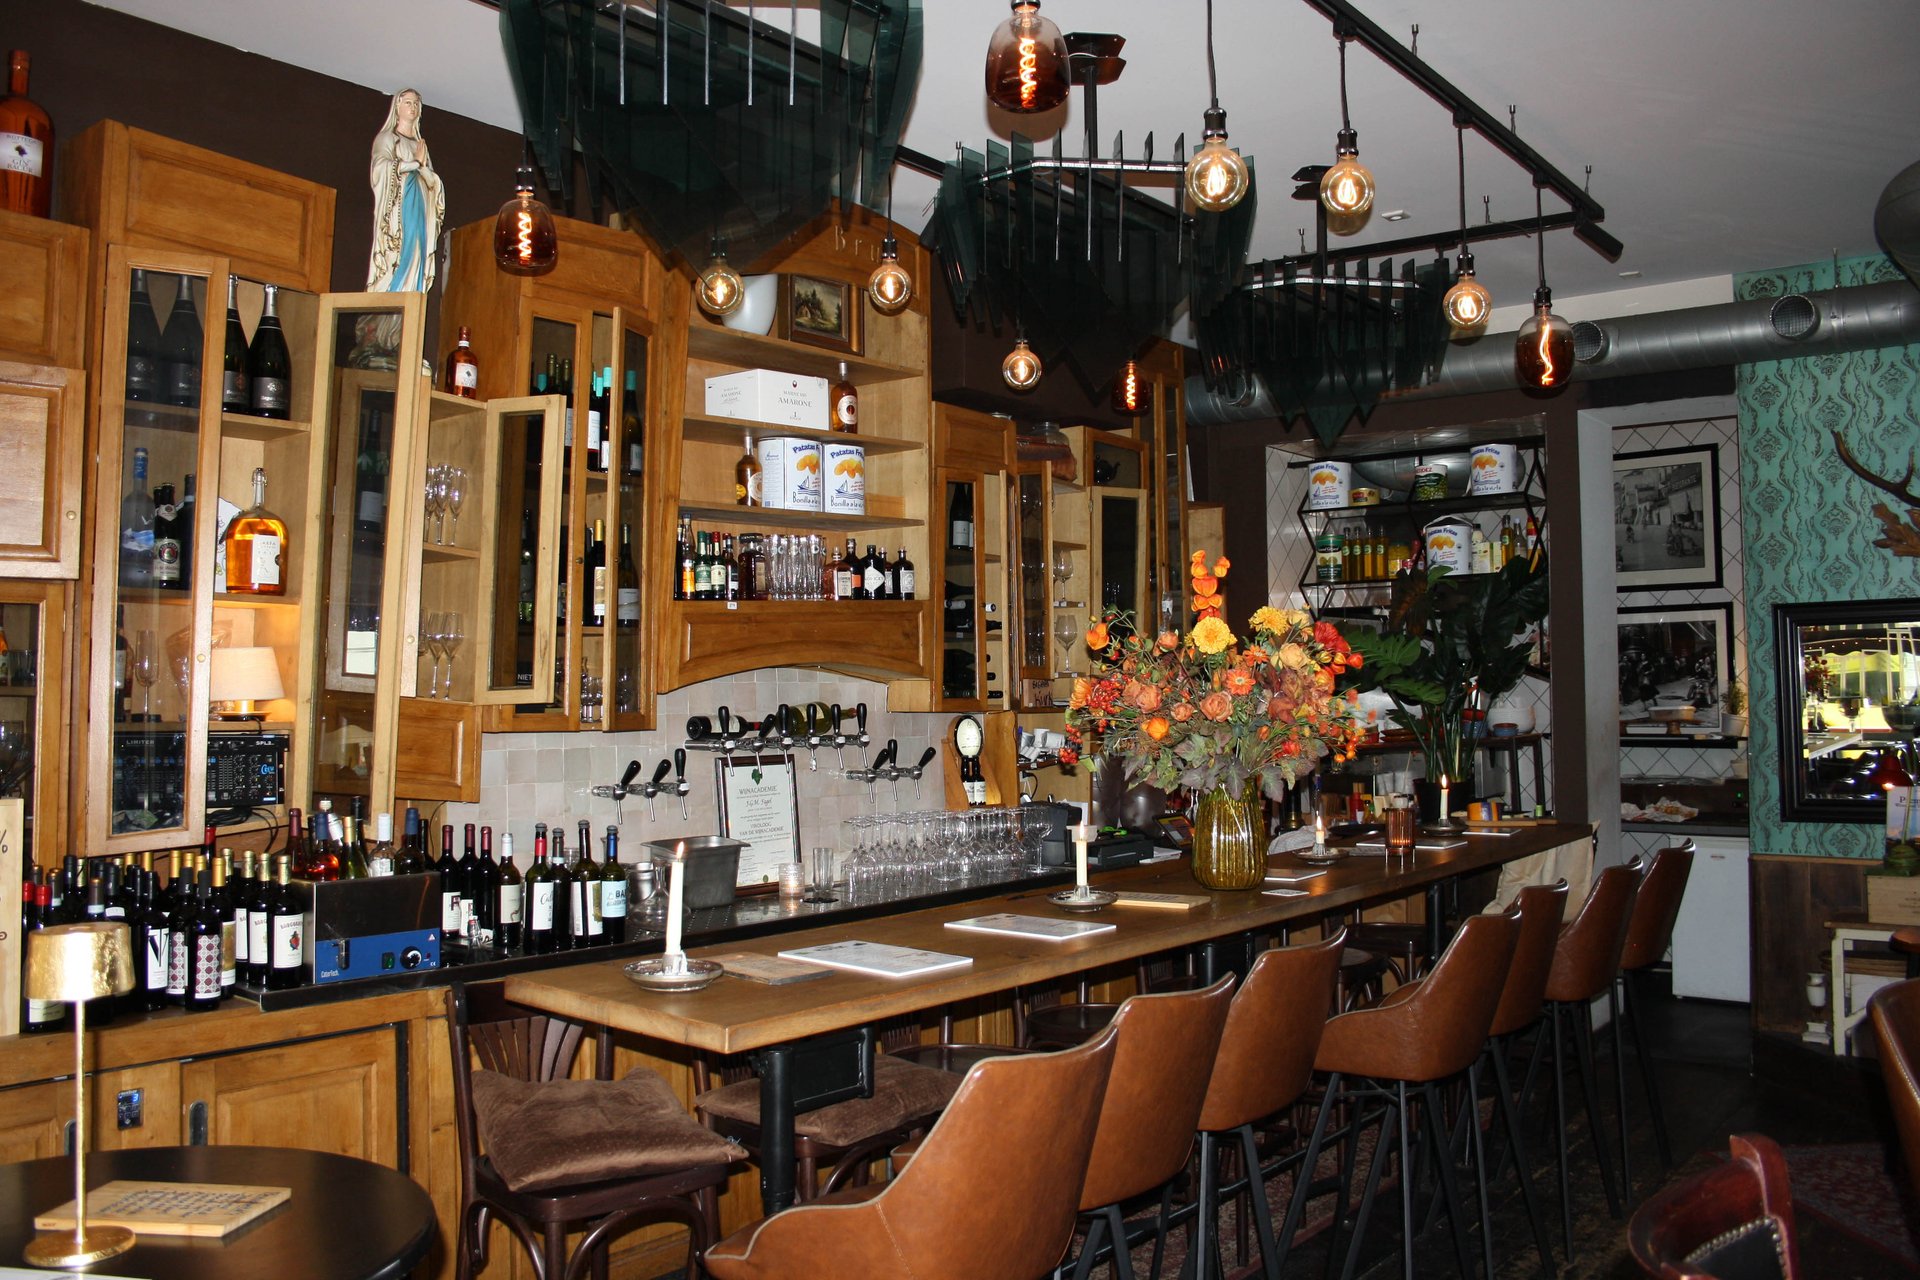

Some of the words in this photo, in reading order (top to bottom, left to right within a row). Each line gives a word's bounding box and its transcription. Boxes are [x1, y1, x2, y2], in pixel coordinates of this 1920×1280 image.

[779, 397, 813, 408] AMARONE
[792, 444, 816, 454] Patatas
[830, 448, 855, 459] Patatas
[1485, 446, 1500, 456] Fritas
[792, 491, 811, 504] Bonilla
[830, 495, 850, 507] Bonilla
[1443, 527, 1458, 537] Fritas
[739, 785, 778, 795] WIJNACADEMIE
